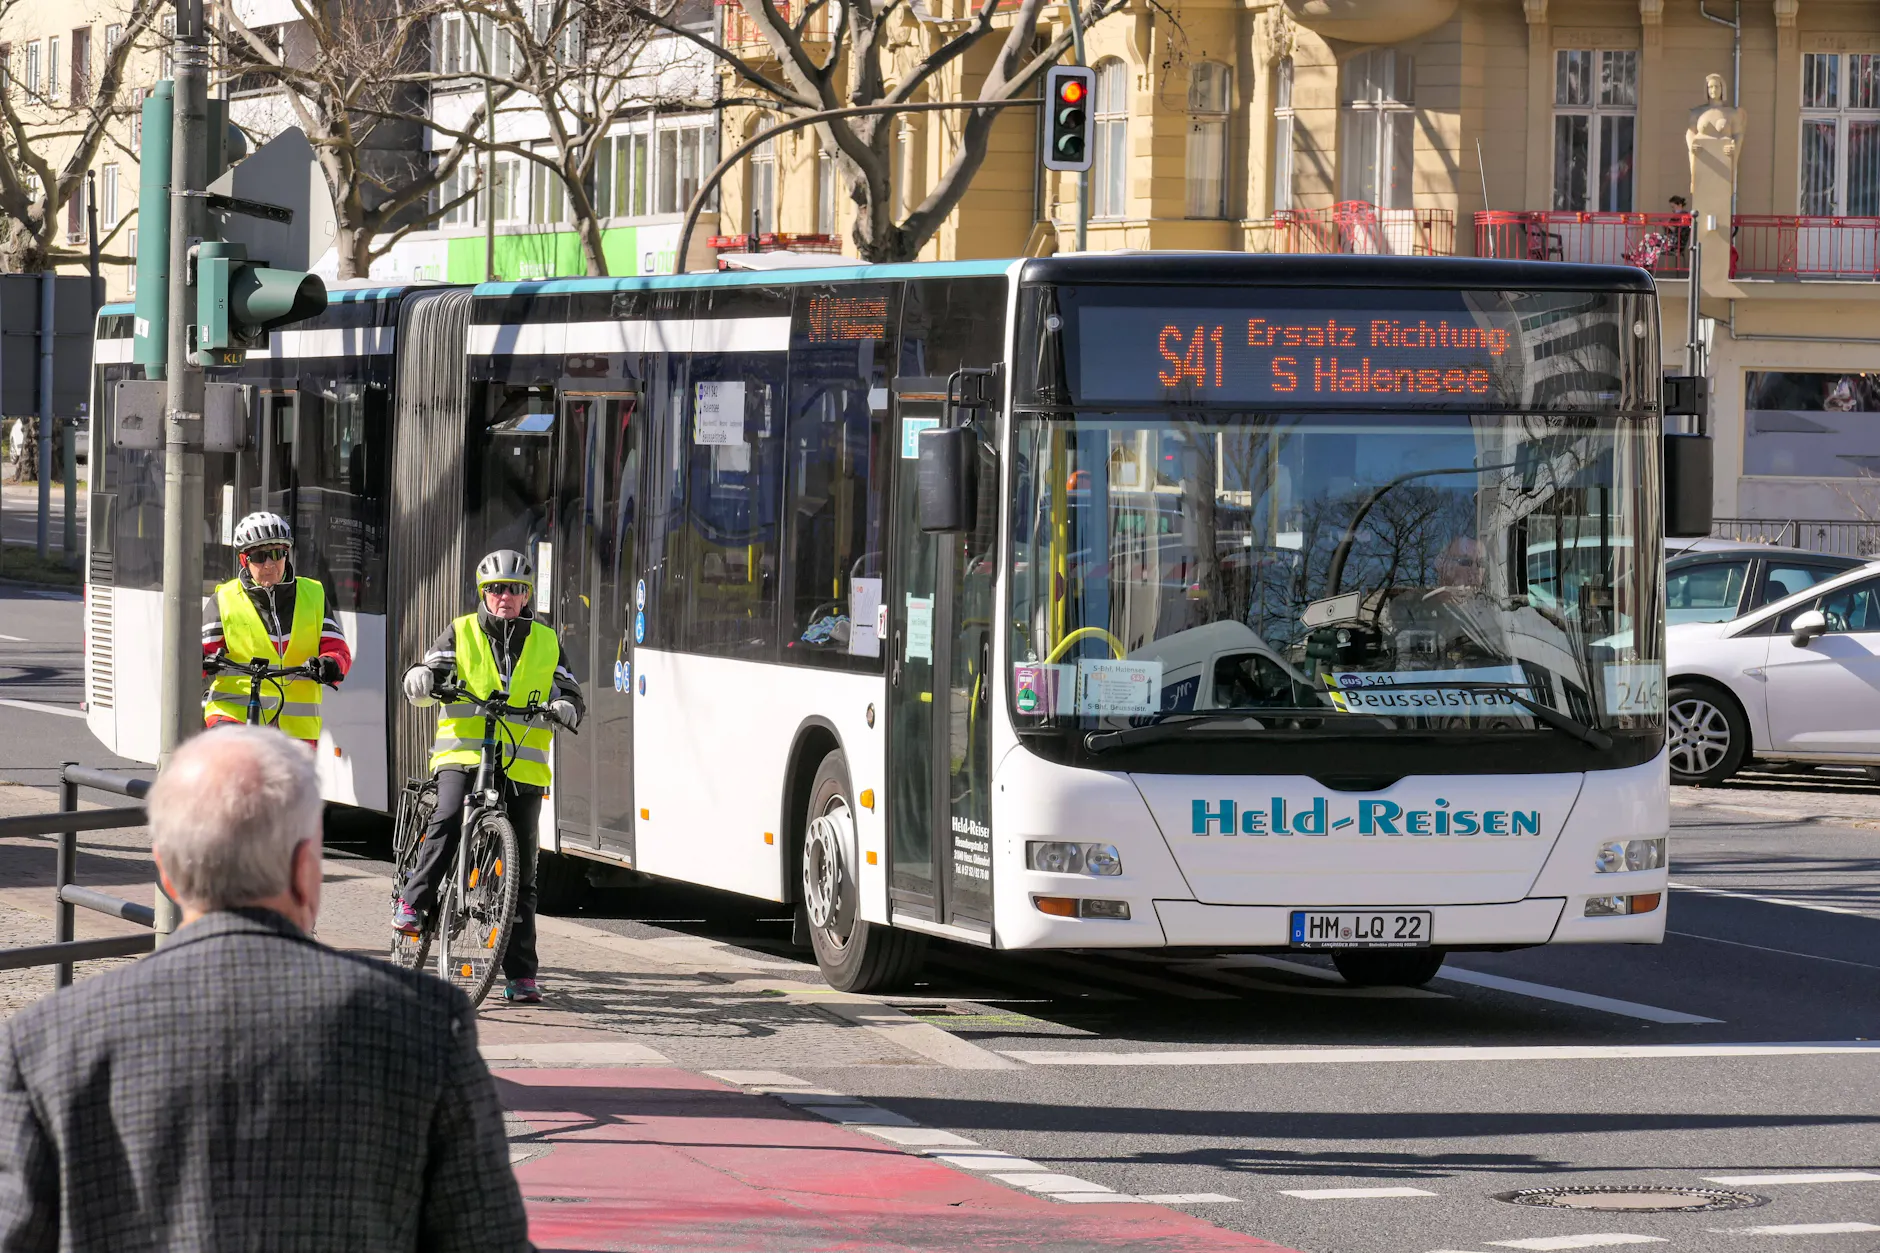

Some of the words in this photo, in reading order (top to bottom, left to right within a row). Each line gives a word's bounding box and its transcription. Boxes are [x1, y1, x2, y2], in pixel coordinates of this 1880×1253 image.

[1248, 319, 1356, 347] Ersatz
[224, 354, 242, 364] KL1
[1158, 325, 1224, 387] S41
[1271, 357, 1296, 392] S
[1313, 357, 1489, 393] Halensee
[1340, 677, 1362, 685] BUS
[1365, 676, 1396, 686] S41
[1024, 690, 1030, 699] 4
[1310, 916, 1339, 938] HM
[1355, 916, 1384, 938] LQ
[1394, 916, 1422, 938] 22
